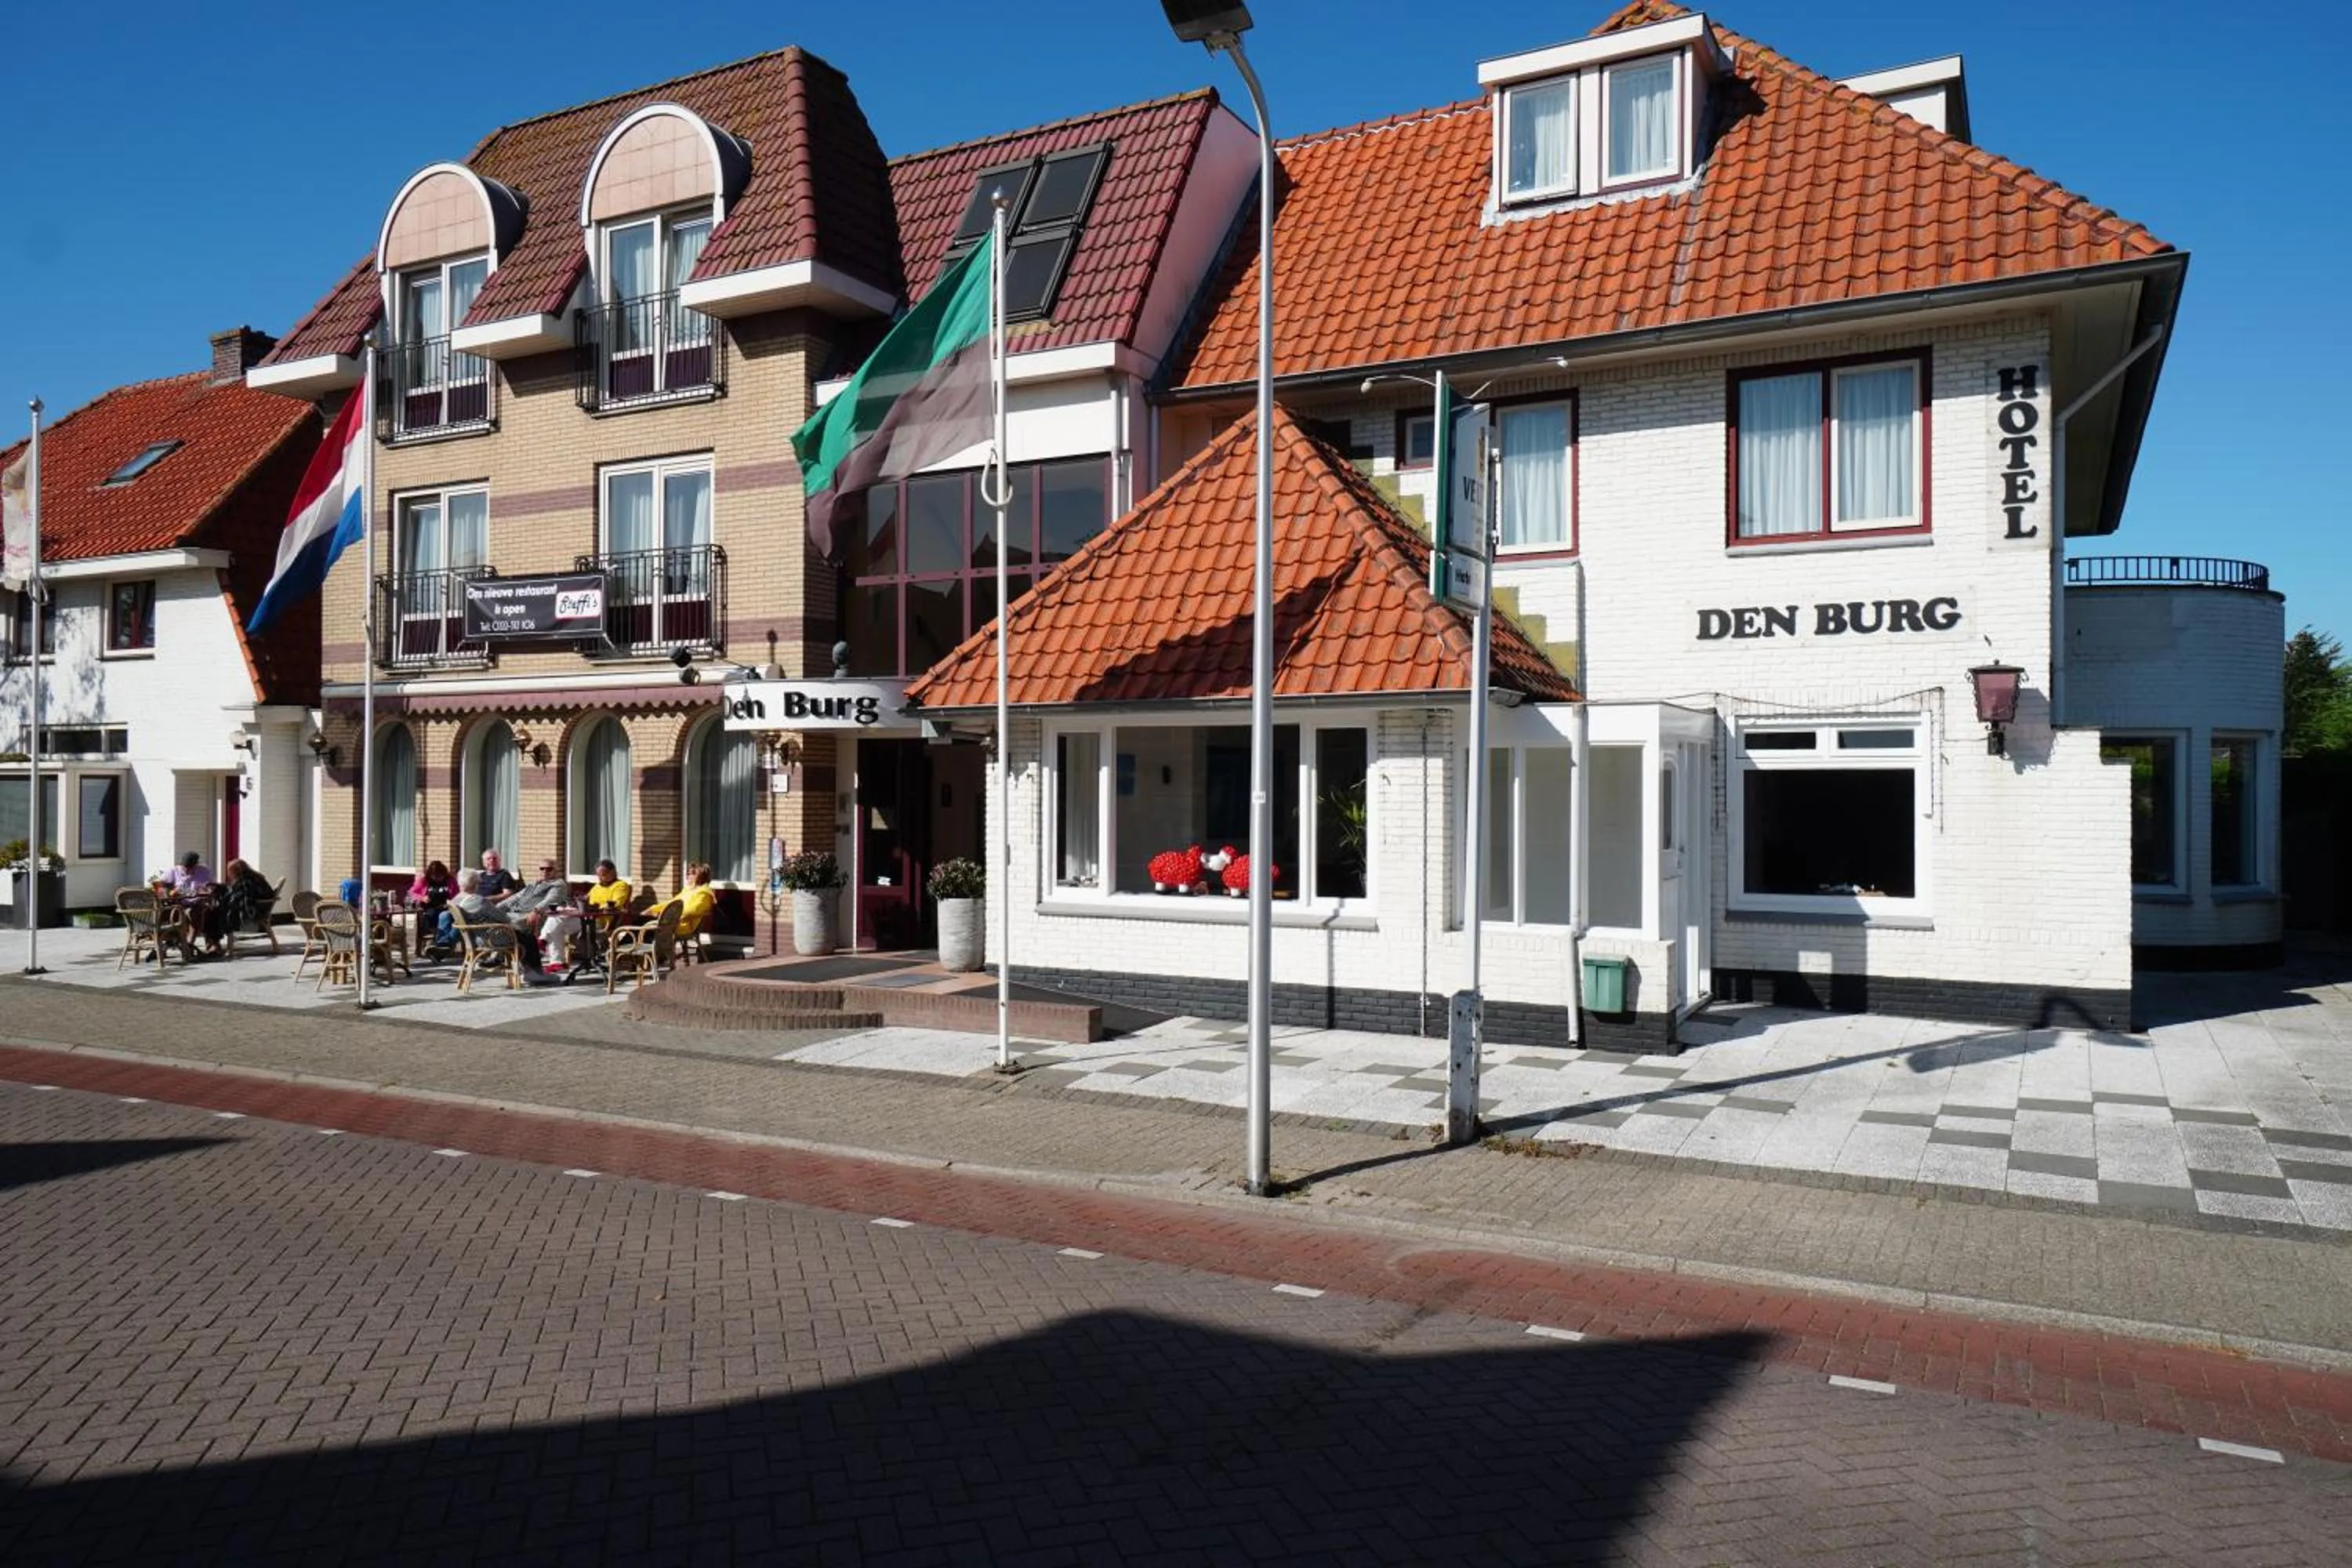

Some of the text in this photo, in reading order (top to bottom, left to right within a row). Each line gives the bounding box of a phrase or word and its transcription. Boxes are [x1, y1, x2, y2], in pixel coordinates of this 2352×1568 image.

[1997, 365, 2038, 539] HOTEL
[484, 587, 514, 598] nieuwe
[515, 584, 557, 597] restaurant
[503, 604, 526, 616] open
[1697, 597, 1961, 640] DEN BURG
[784, 691, 880, 724] Burg
